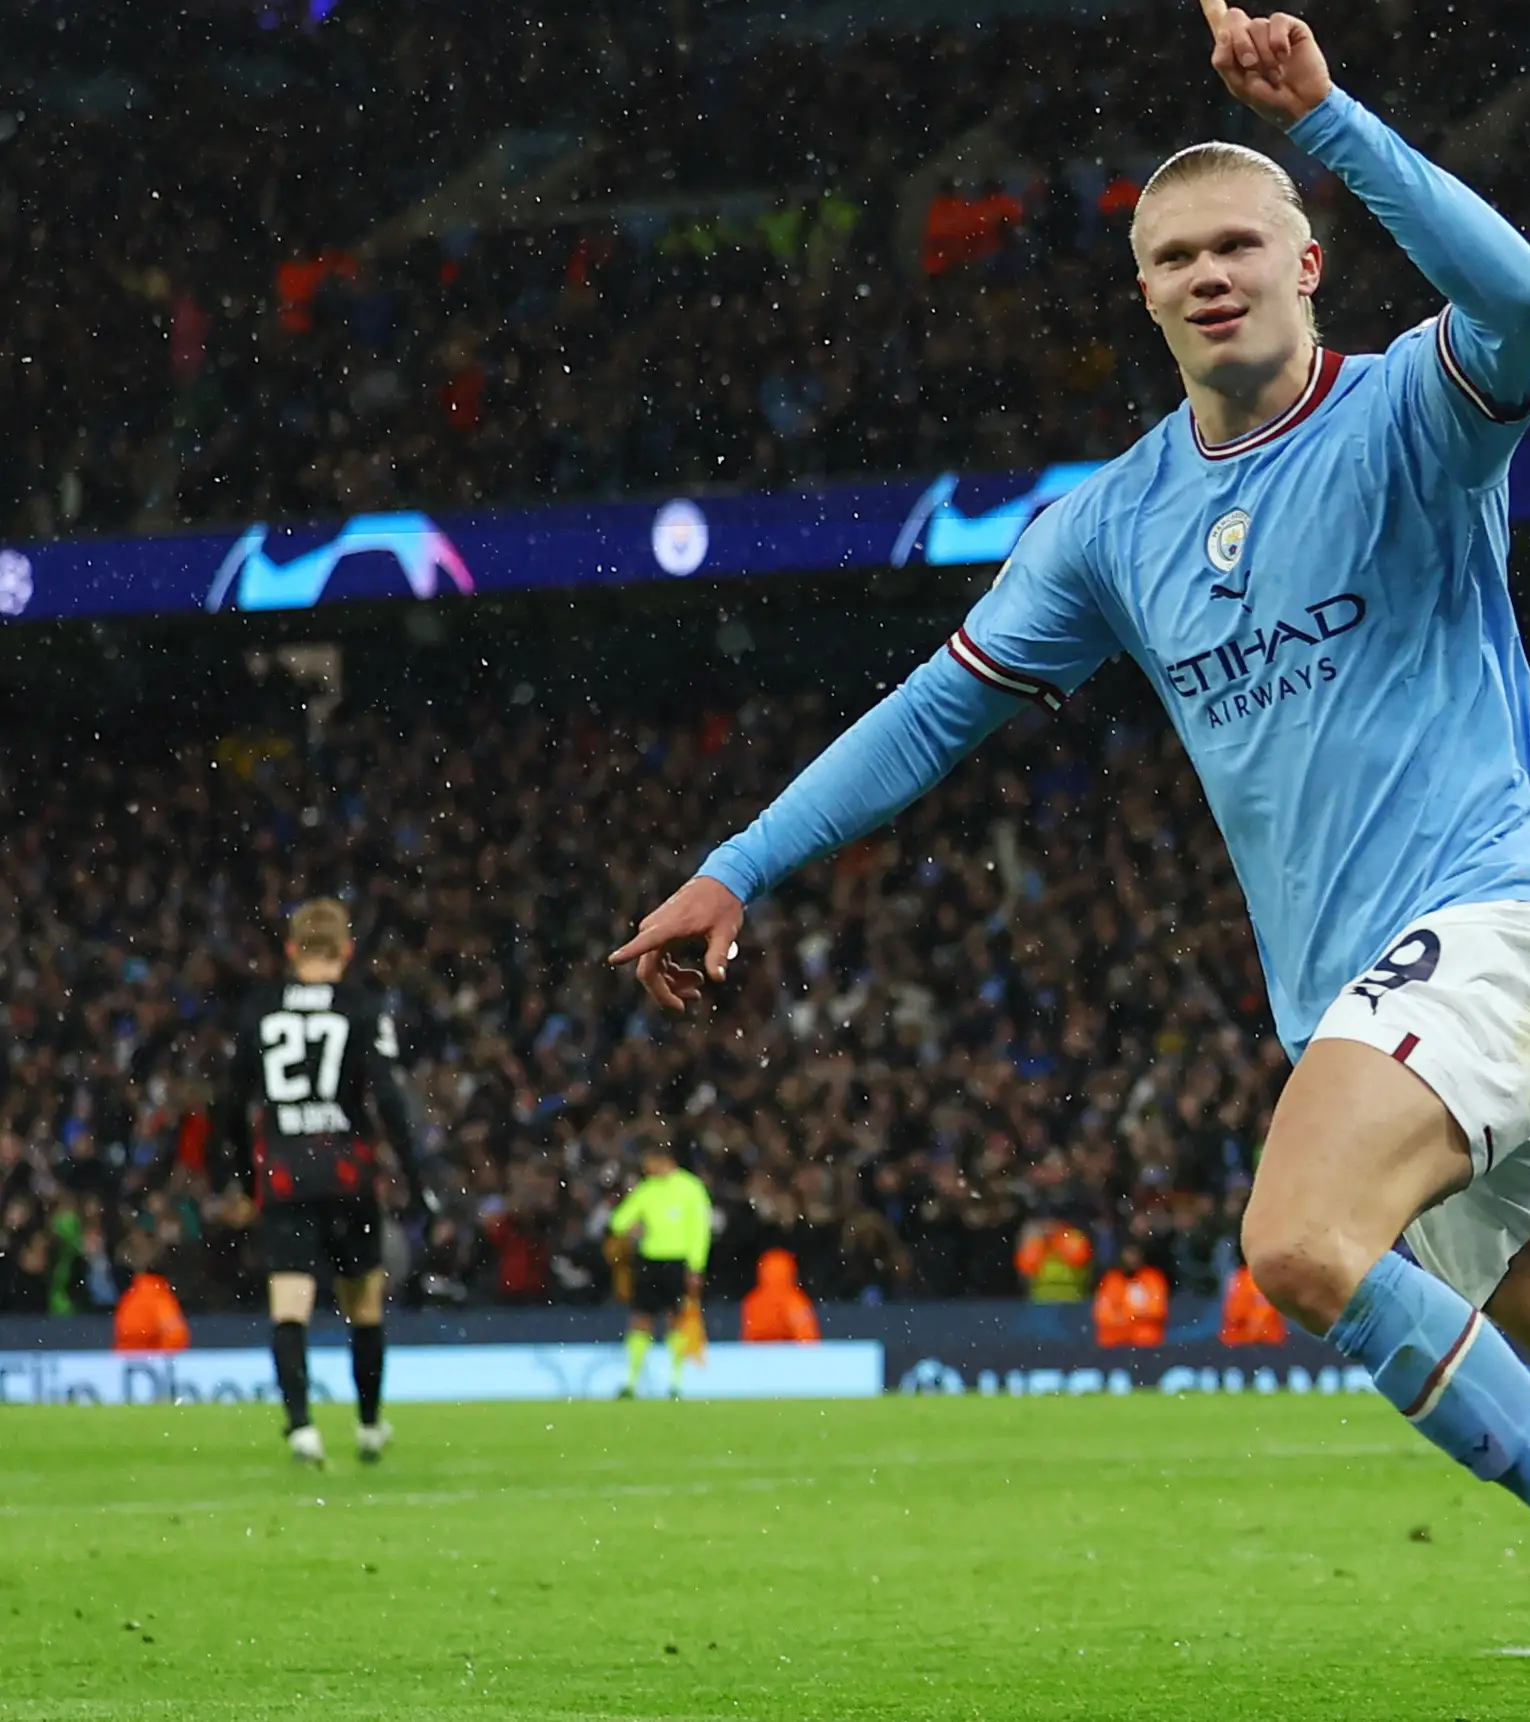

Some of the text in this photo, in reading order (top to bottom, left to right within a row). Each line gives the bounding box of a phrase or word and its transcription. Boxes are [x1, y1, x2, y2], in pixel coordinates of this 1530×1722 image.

[1166, 593, 1366, 697] ETIHAD
[1207, 657, 1337, 729] AIRWAYS
[1358, 928, 1442, 990] 9
[260, 1011, 350, 1102] 27
